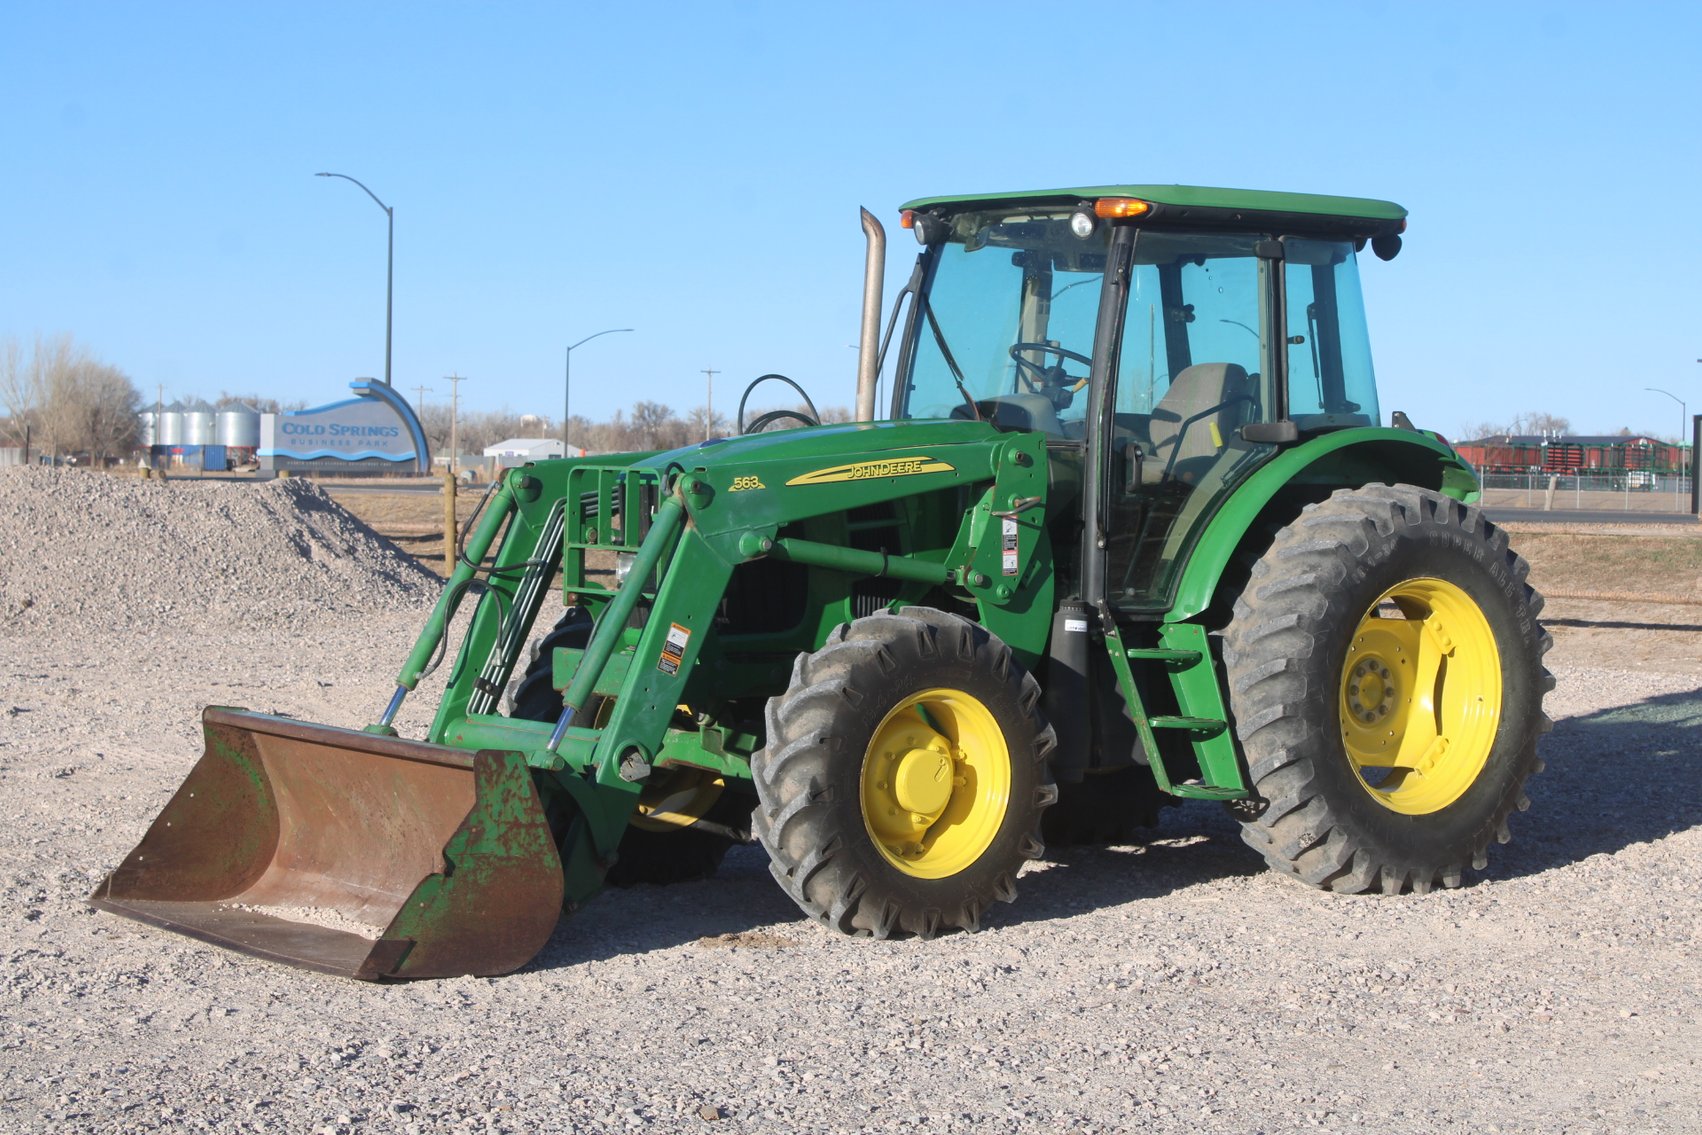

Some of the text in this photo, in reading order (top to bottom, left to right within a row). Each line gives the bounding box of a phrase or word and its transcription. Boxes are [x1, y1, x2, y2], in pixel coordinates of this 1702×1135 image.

[282, 423, 399, 438] COLD SPRINGS
[290, 438, 389, 449] BUSINESS PARK
[847, 460, 923, 479] JOHN DEERE
[733, 476, 760, 490] 563
